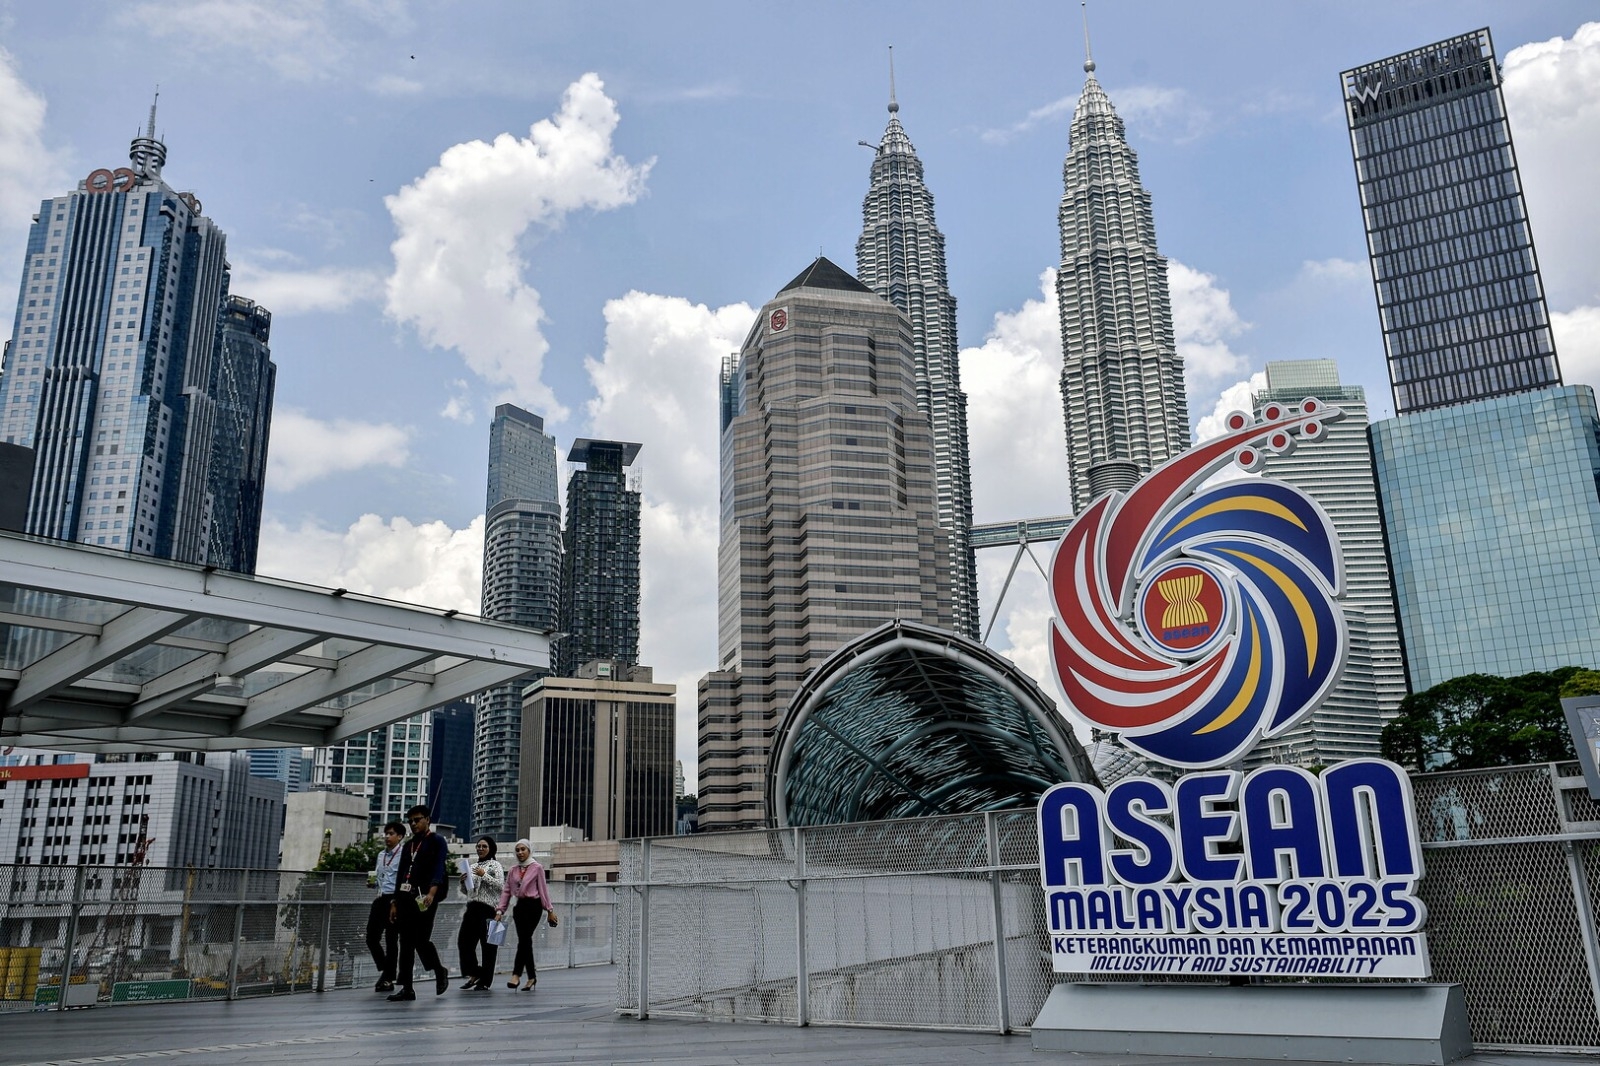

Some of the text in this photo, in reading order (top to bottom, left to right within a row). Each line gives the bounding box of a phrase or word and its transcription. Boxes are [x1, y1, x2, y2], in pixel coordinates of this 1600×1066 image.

[1353, 81, 1382, 105] W
[1162, 625, 1210, 641] asean
[1041, 762, 1414, 887] ASEAN
[1049, 881, 1417, 931] MALAYSIA 2025
[1054, 937, 1416, 956] KETERANGKUMAN DAN KEMAMPANAN
[1090, 956, 1382, 974] INCLUSIVITY AND SUSTAINABILITY
